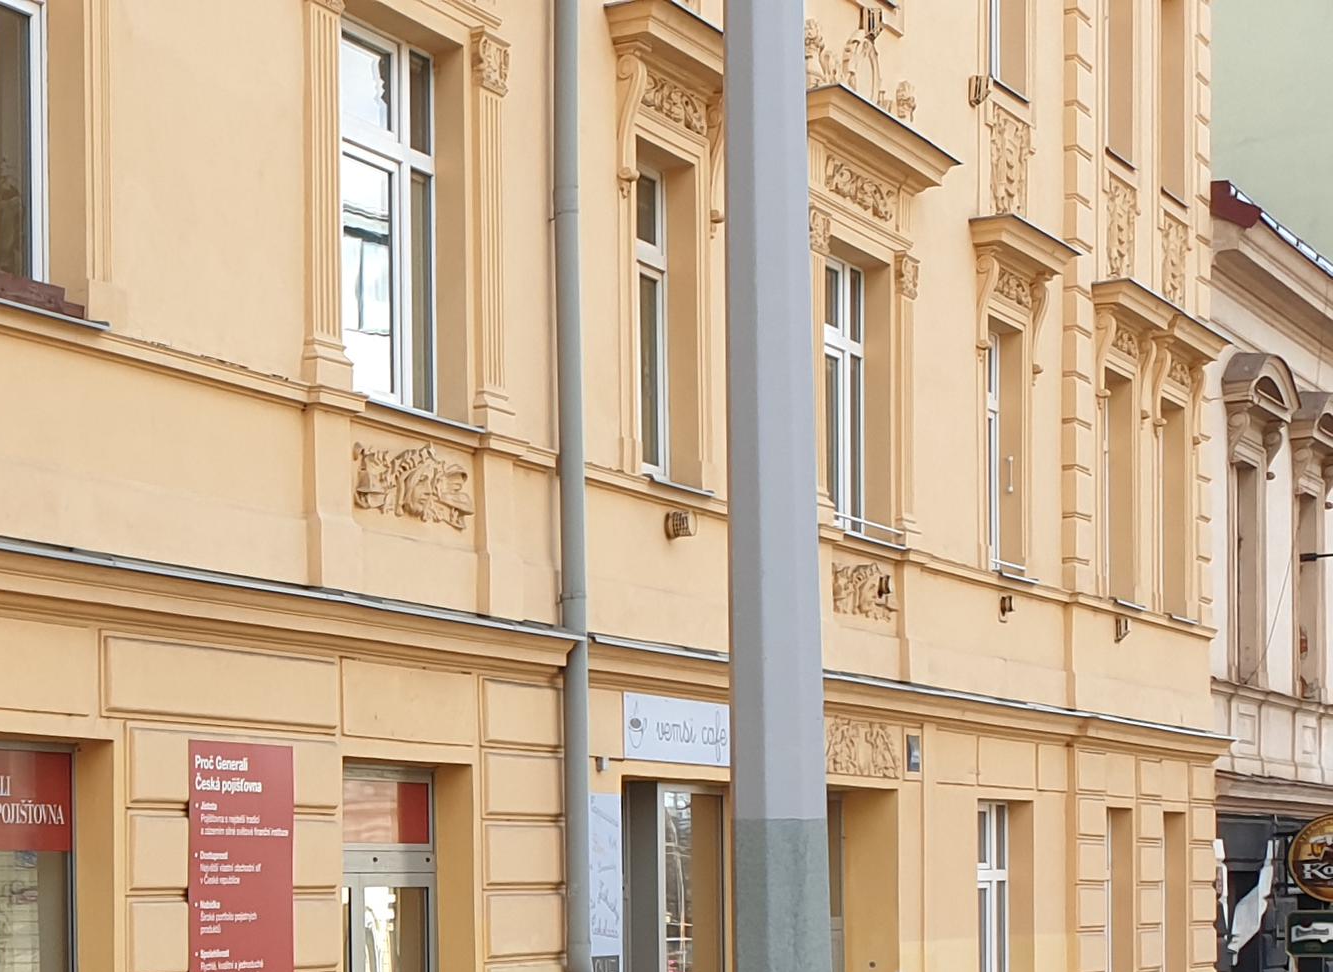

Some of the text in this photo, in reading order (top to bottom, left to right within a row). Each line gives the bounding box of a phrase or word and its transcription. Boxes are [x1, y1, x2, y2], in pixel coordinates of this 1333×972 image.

[195, 755, 248, 771] Proč Generali
[195, 773, 262, 794] Česká pojišťovna
